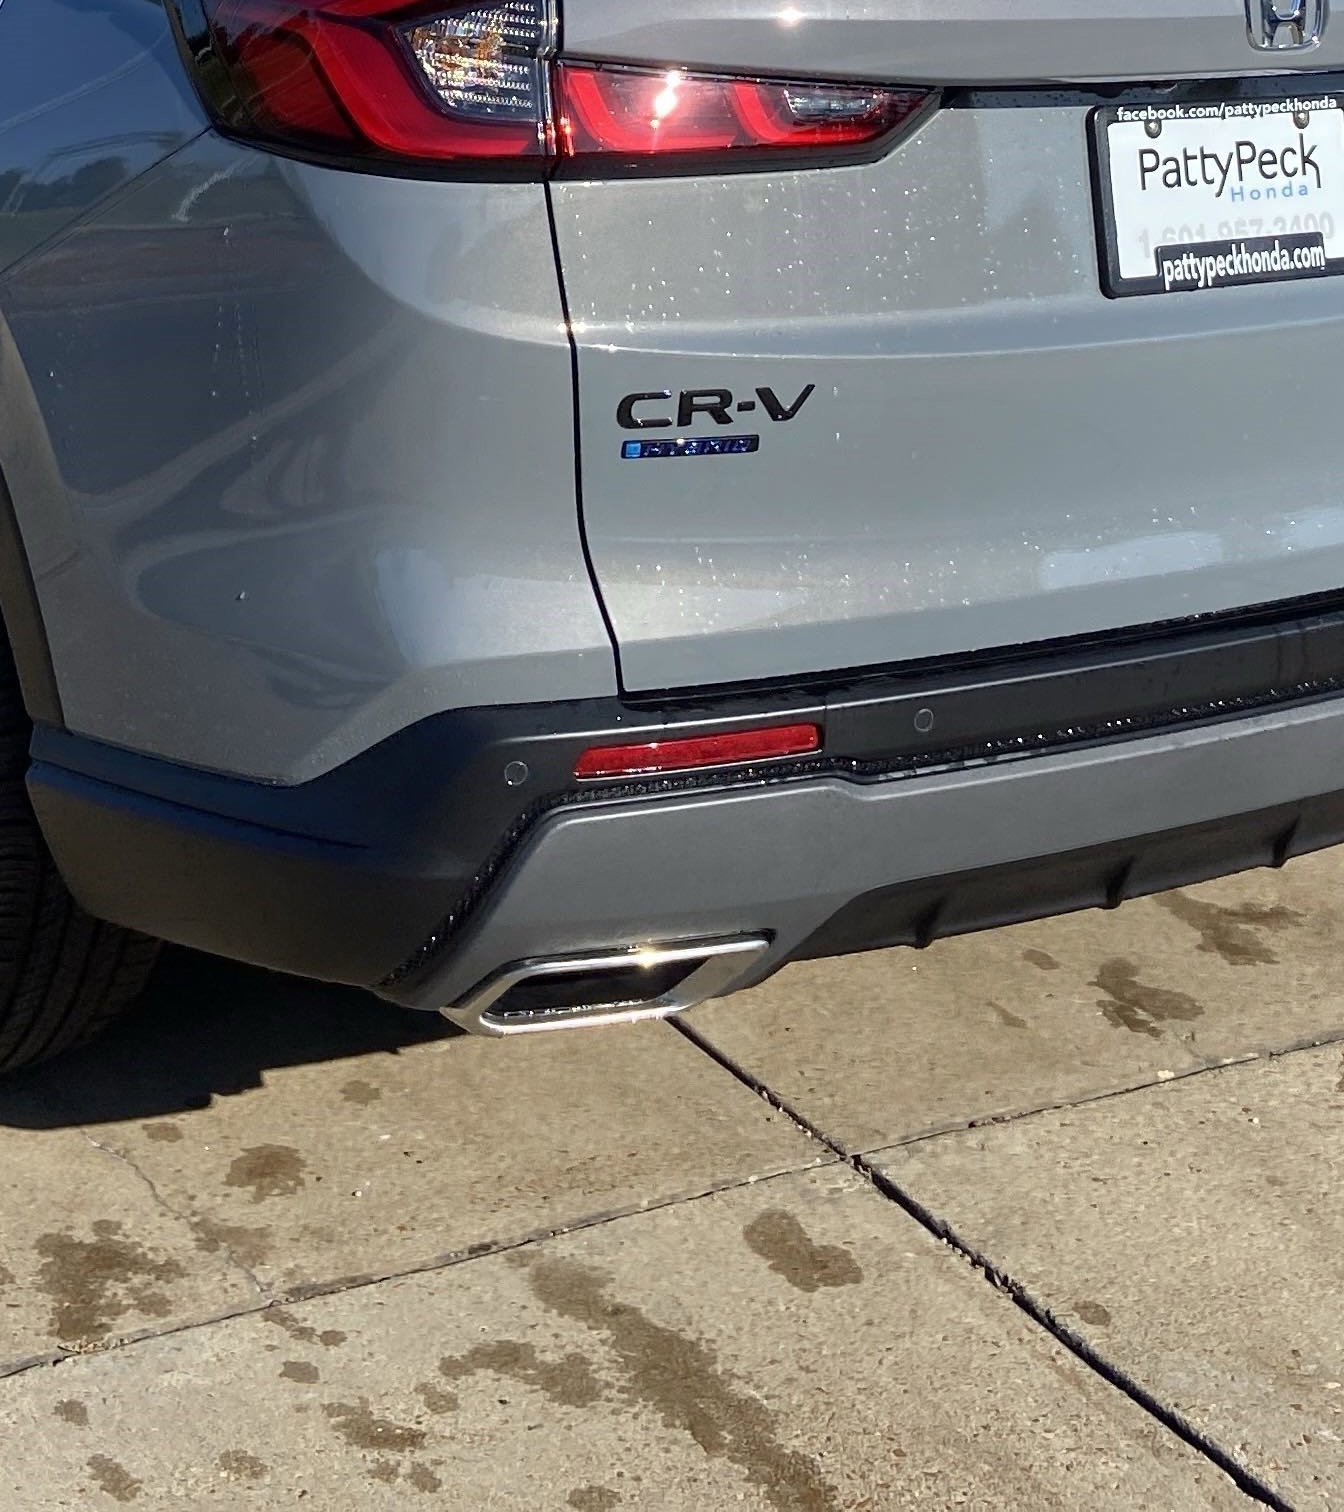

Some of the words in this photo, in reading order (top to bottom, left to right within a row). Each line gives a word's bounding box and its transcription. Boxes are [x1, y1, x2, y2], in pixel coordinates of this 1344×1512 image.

[1116, 95, 1338, 123] facebook.com/pattypeckhonda
[1138, 133, 1322, 198] PattyPeck
[1230, 181, 1309, 203] Honda
[1162, 239, 1326, 291] pattypeckhonda.com
[616, 383, 816, 429] CR-V
